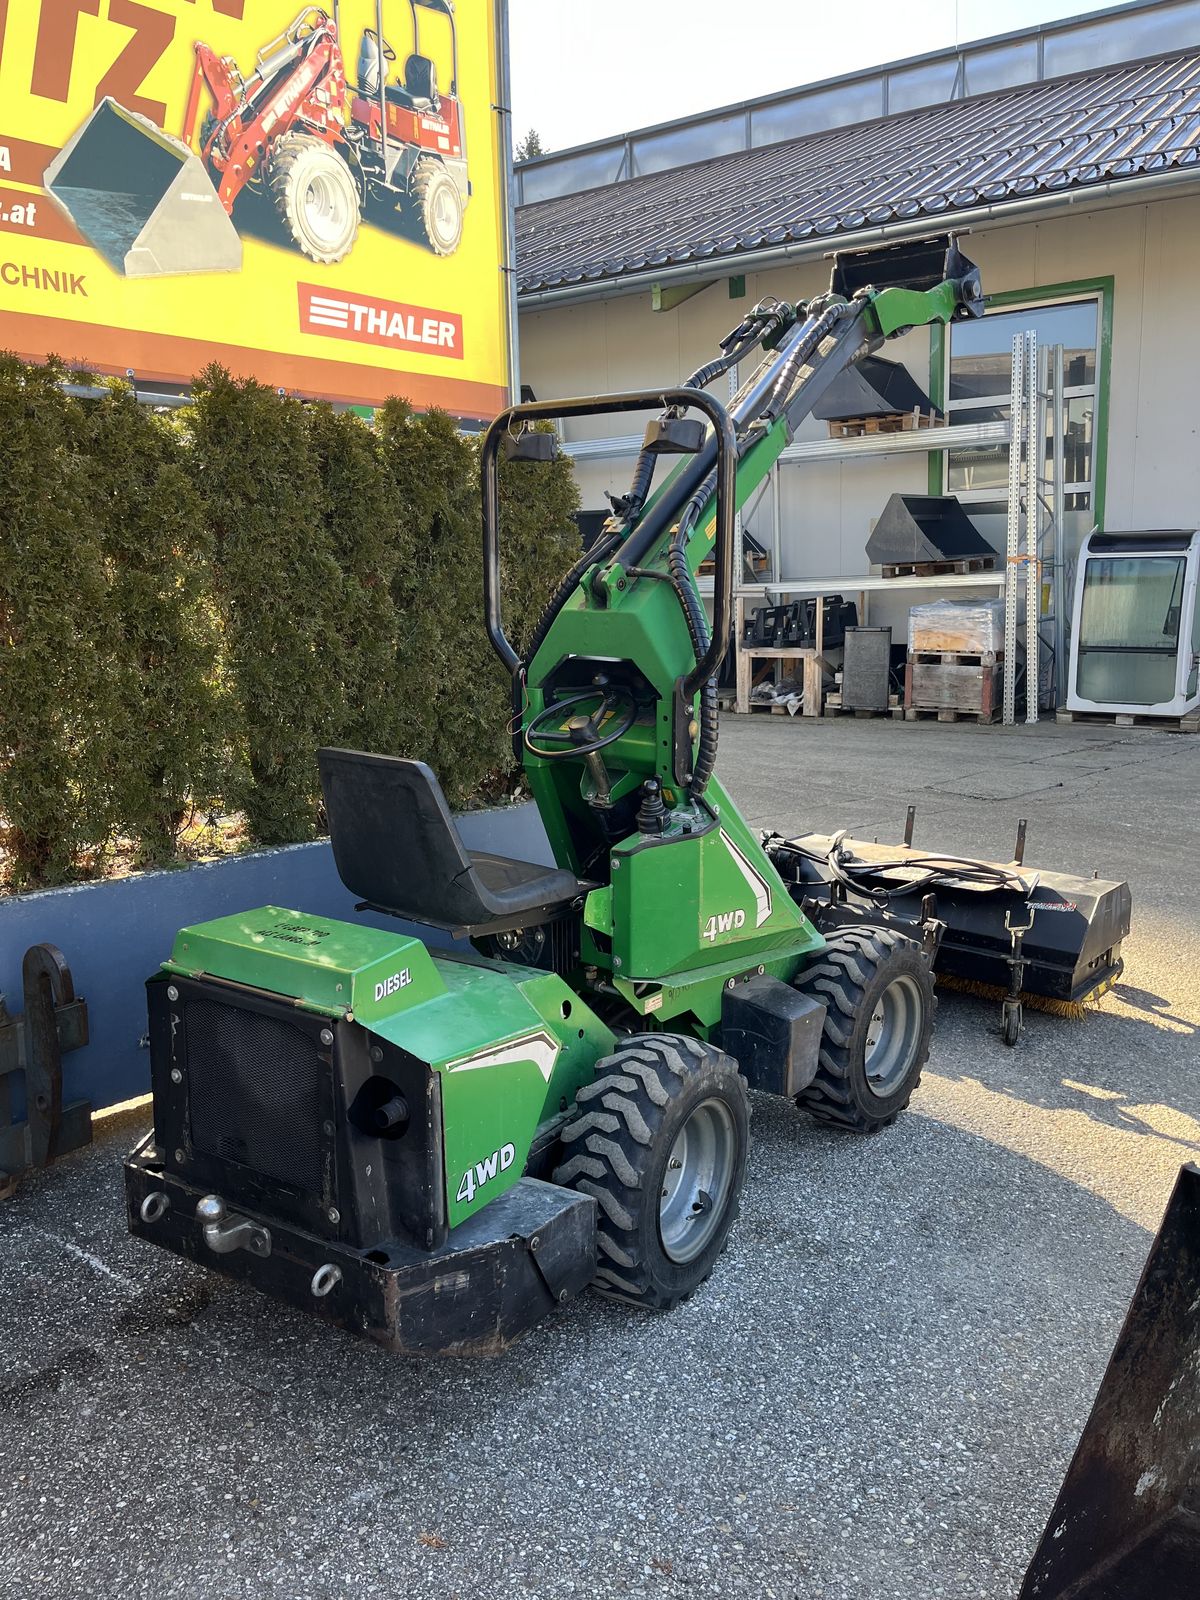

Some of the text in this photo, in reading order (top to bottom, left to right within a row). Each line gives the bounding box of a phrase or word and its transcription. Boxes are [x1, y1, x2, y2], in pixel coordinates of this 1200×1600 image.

[0, 0, 176, 129] TZ
[0, 202, 36, 227] .at
[0, 262, 89, 297] CHNIK
[349, 303, 456, 348] THALER
[703, 908, 746, 942] 4WD
[374, 967, 413, 1002] DIESEL
[456, 1142, 516, 1203] 4WD
